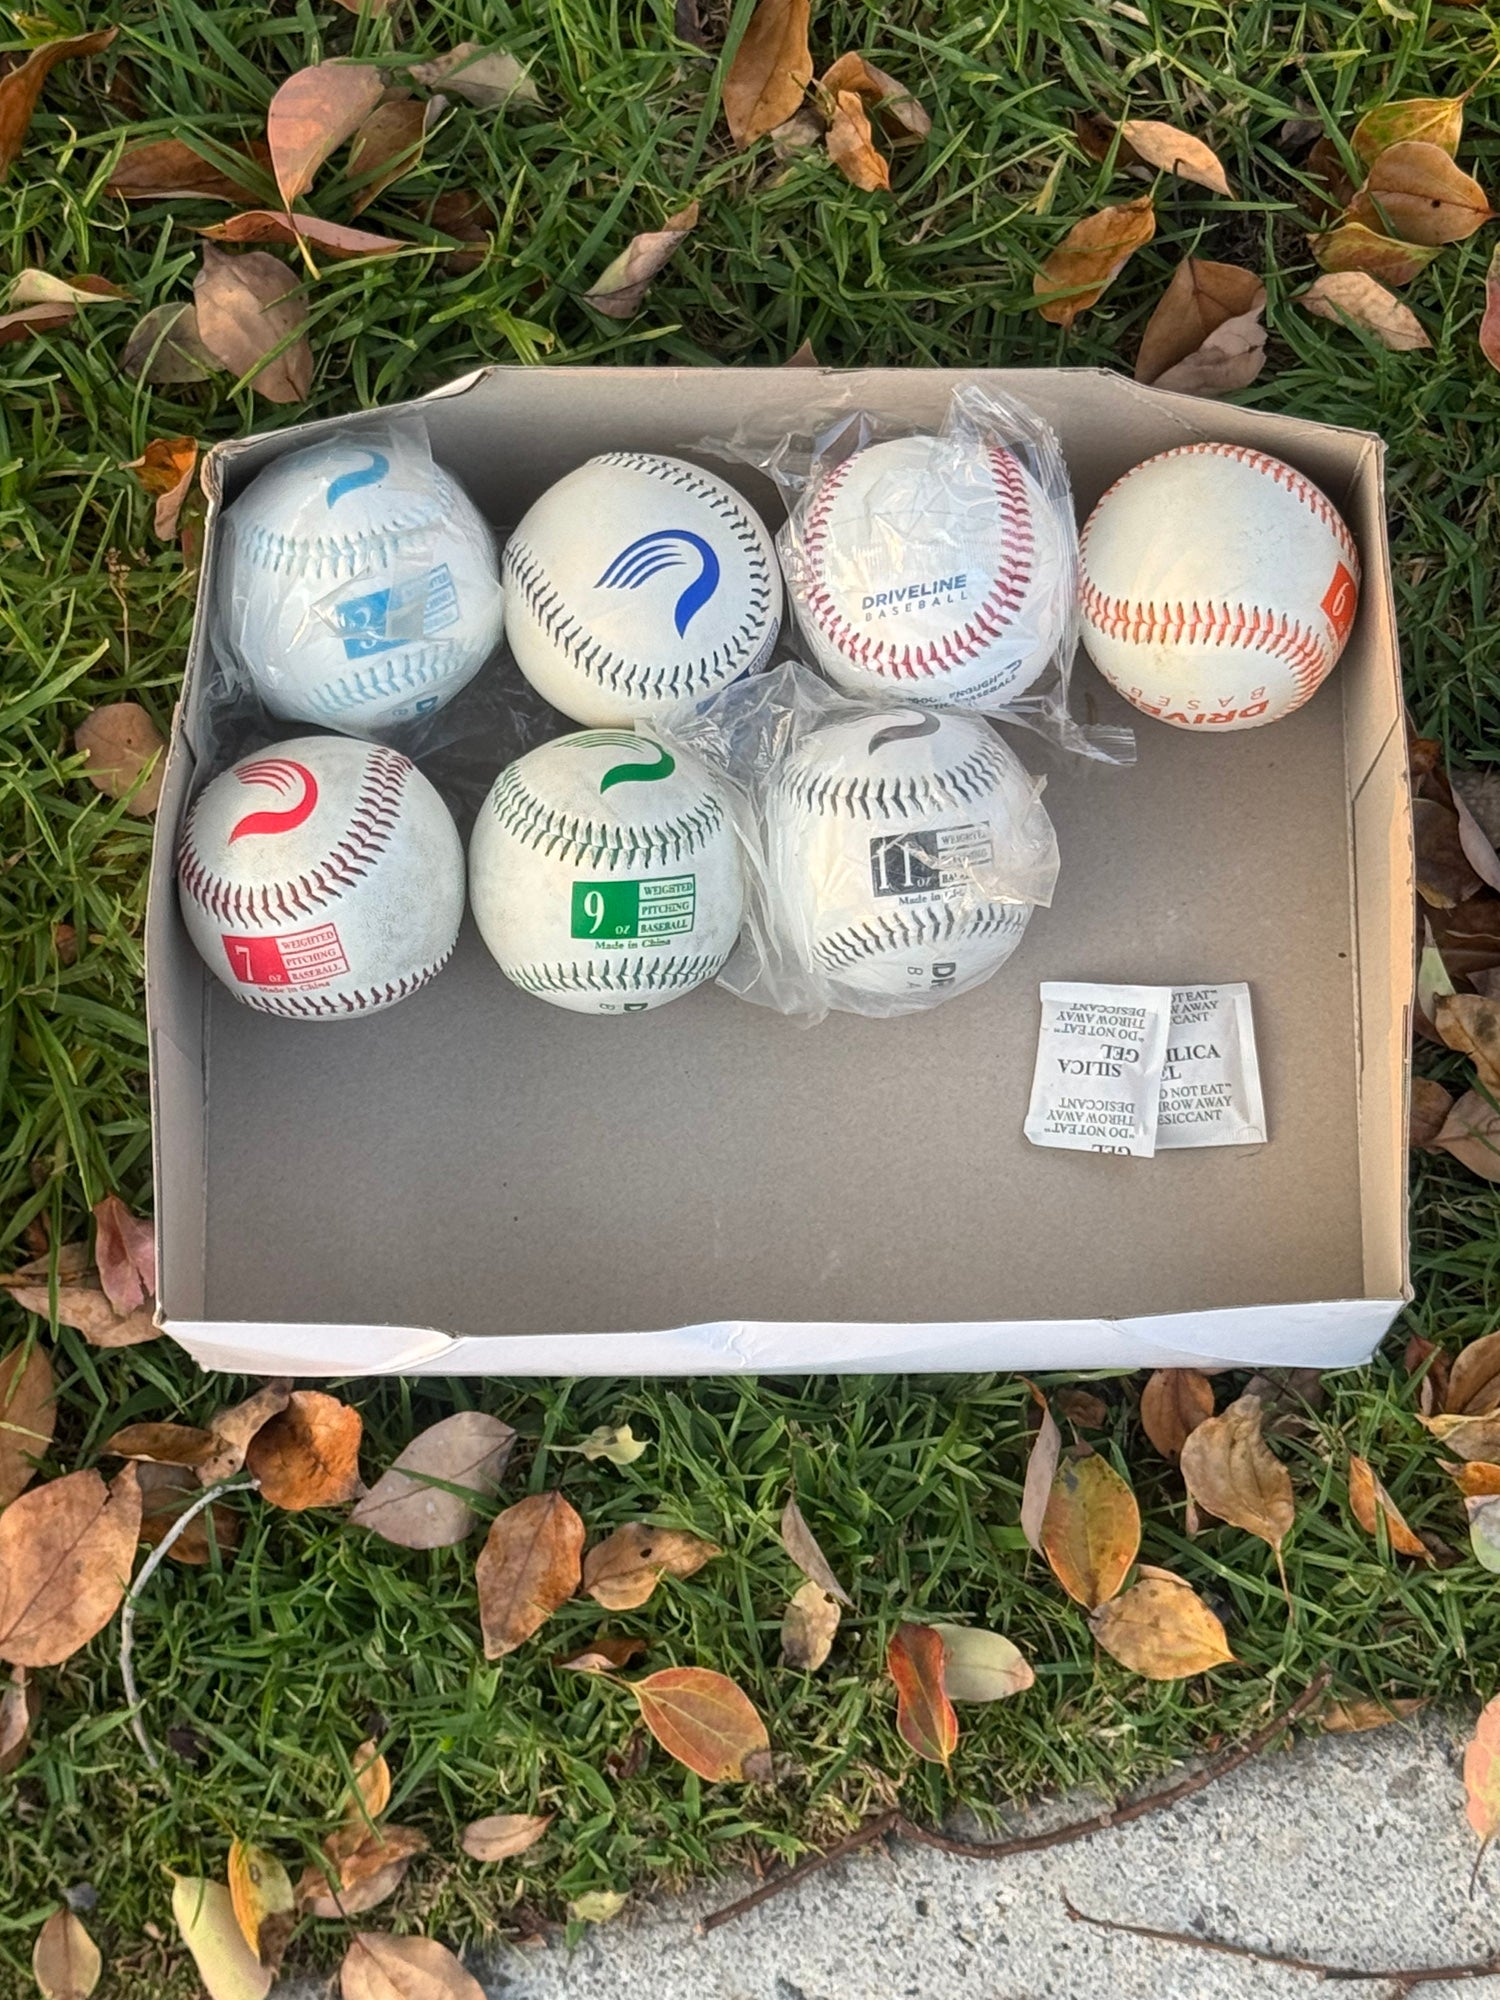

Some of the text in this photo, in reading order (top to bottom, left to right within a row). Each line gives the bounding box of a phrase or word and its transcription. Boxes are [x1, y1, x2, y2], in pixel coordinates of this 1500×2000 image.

[861, 573, 968, 611] DRIVELINE
[1331, 581, 1351, 617] 6
[864, 590, 968, 622] BASEBALL
[875, 838, 915, 890] 11
[643, 881, 693, 897] WEIGHTED
[641, 900, 690, 916] PITCHING
[898, 895, 928, 906] Made
[930, 892, 942, 902] in
[583, 890, 606, 935] 9
[639, 918, 689, 935] BASEBALL
[281, 930, 335, 950] WEIGHTED
[594, 937, 672, 950] Made in China
[234, 944, 254, 981] 7
[285, 947, 337, 967] PITCHING
[291, 963, 342, 981] BASEBALL
[258, 980, 331, 994] Made in China
[1069, 1002, 1147, 1018] DESICCANT
[1181, 1000, 1219, 1014] AWAY
[1055, 1010, 1146, 1030] THROW AWAY
[1087, 1025, 1116, 1038] NOT
[1099, 1043, 1140, 1064] GEL
[1165, 1043, 1222, 1064] ILICA
[1057, 1058, 1123, 1078] SILICA
[1170, 1083, 1199, 1099] NOT
[1058, 1097, 1136, 1115] DESICCANT
[1194, 1095, 1232, 1109] AWAY
[1046, 1108, 1136, 1127] THROW AWAY
[1157, 1109, 1223, 1126] ESICCANT
[1077, 1124, 1107, 1138] NOT
